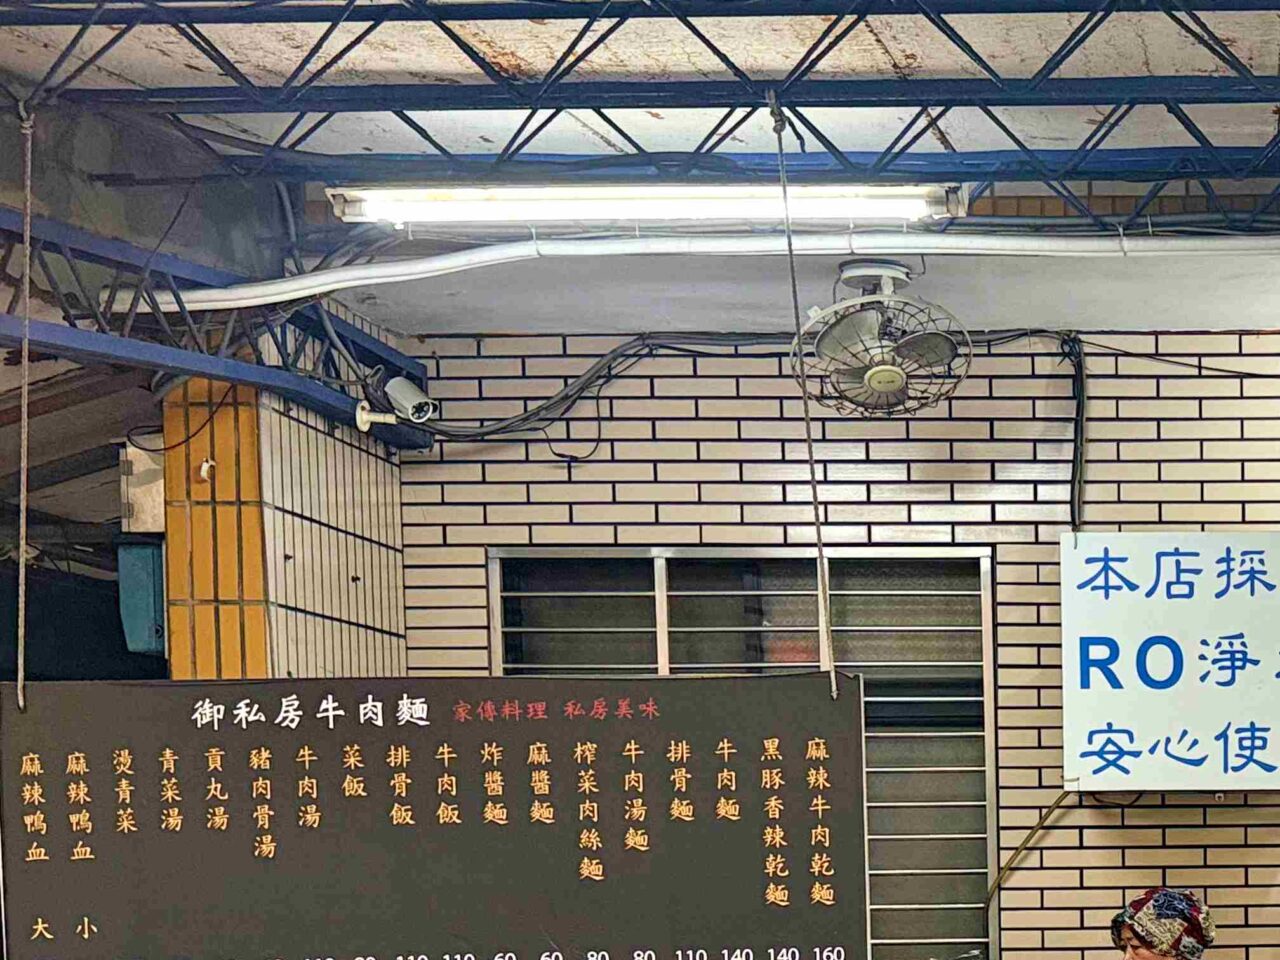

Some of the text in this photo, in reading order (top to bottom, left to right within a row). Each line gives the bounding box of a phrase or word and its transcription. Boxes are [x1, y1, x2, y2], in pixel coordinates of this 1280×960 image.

[191, 693, 430, 731] 御私房牛肉麵
[19, 751, 51, 863] 麻辣鴨血
[66, 751, 95, 861] 麻辣鴨血
[114, 747, 138, 833] 燙青菜
[159, 747, 185, 832] 青菜湯
[205, 746, 231, 831] 貢丸湯
[249, 746, 279, 859] 豬肉骨湯
[297, 744, 324, 829] 牛肉湯
[342, 743, 367, 798] 菜飯
[387, 744, 415, 826] 排骨飯
[436, 743, 462, 825] 牛肉飯
[480, 742, 510, 826] 炸醬麵
[527, 741, 556, 824] 麻醬麵
[623, 739, 651, 852] 牛肉湯麵
[667, 740, 696, 823] 排骨麵
[716, 738, 742, 822] 牛肉麵
[806, 737, 836, 907] 麻辣牛肉乾麵
[30, 917, 54, 940] 大
[75, 916, 98, 940] 小
